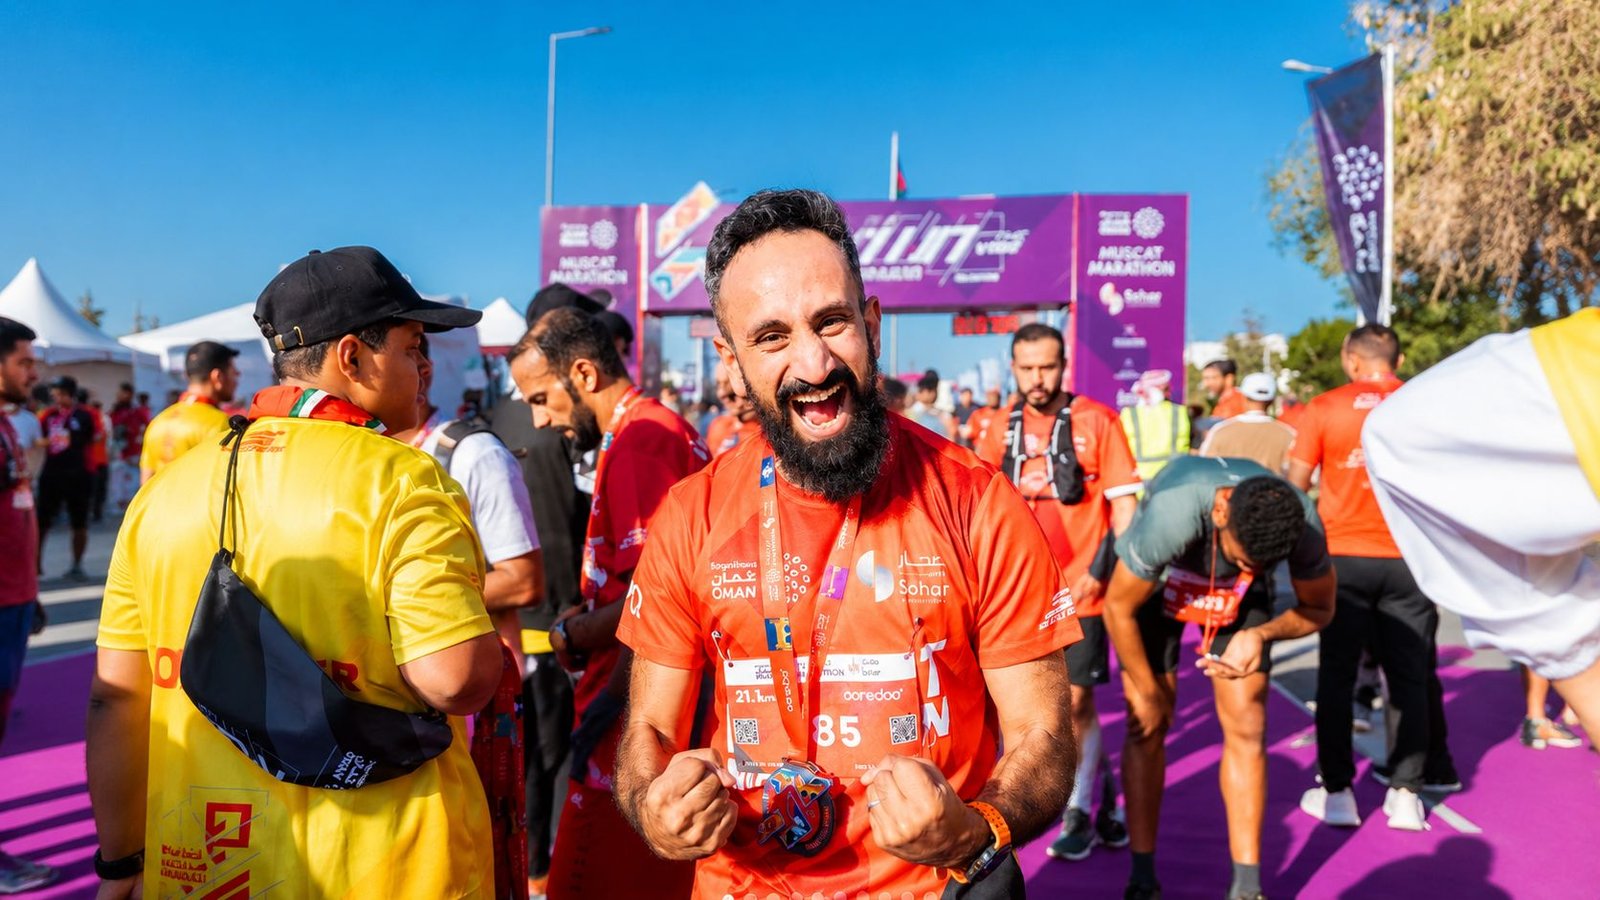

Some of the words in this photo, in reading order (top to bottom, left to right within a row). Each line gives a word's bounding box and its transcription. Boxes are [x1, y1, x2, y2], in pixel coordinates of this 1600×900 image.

[1098, 246, 1164, 261] MUSCAT
[559, 256, 617, 270] MUSCAT
[1087, 260, 1175, 277] MARATHON
[549, 269, 628, 285] MARATHON
[711, 586, 757, 600] OMAN
[899, 578, 949, 596] Sohar
[843, 688, 903, 701] ooredoo
